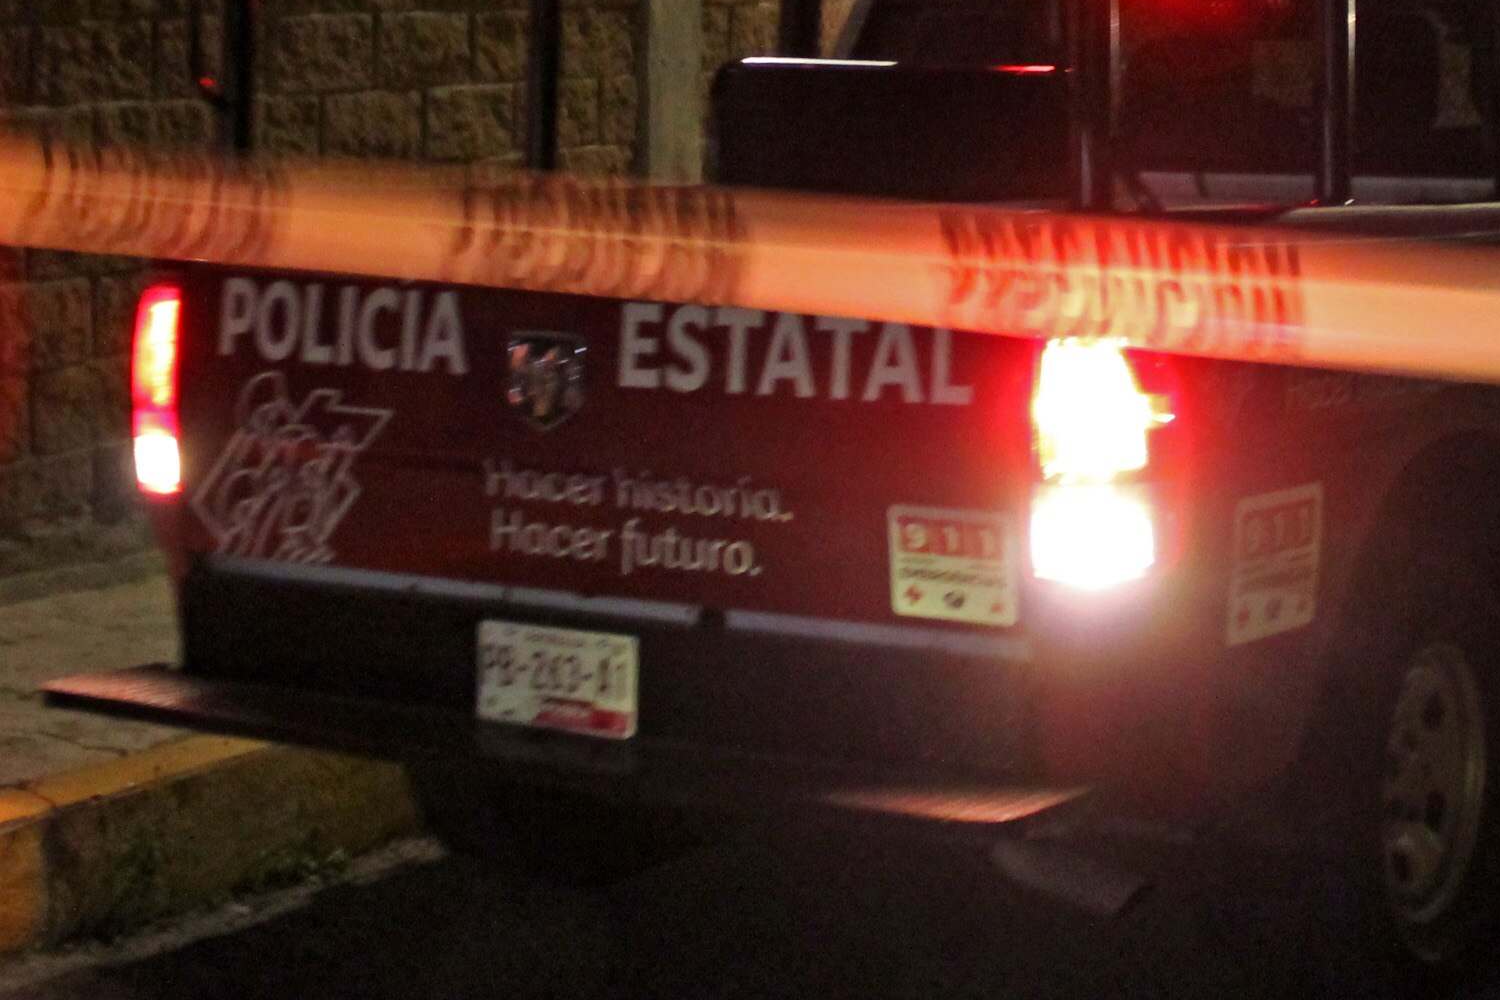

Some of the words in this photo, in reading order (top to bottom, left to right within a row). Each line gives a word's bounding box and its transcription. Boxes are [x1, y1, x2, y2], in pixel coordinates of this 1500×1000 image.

[616, 301, 975, 406] ESTATAL
[484, 458, 604, 506] Hacer
[613, 467, 794, 522] historia.
[489, 508, 615, 561] Hacer
[619, 517, 763, 576] futuro.
[903, 522, 998, 558] 911
